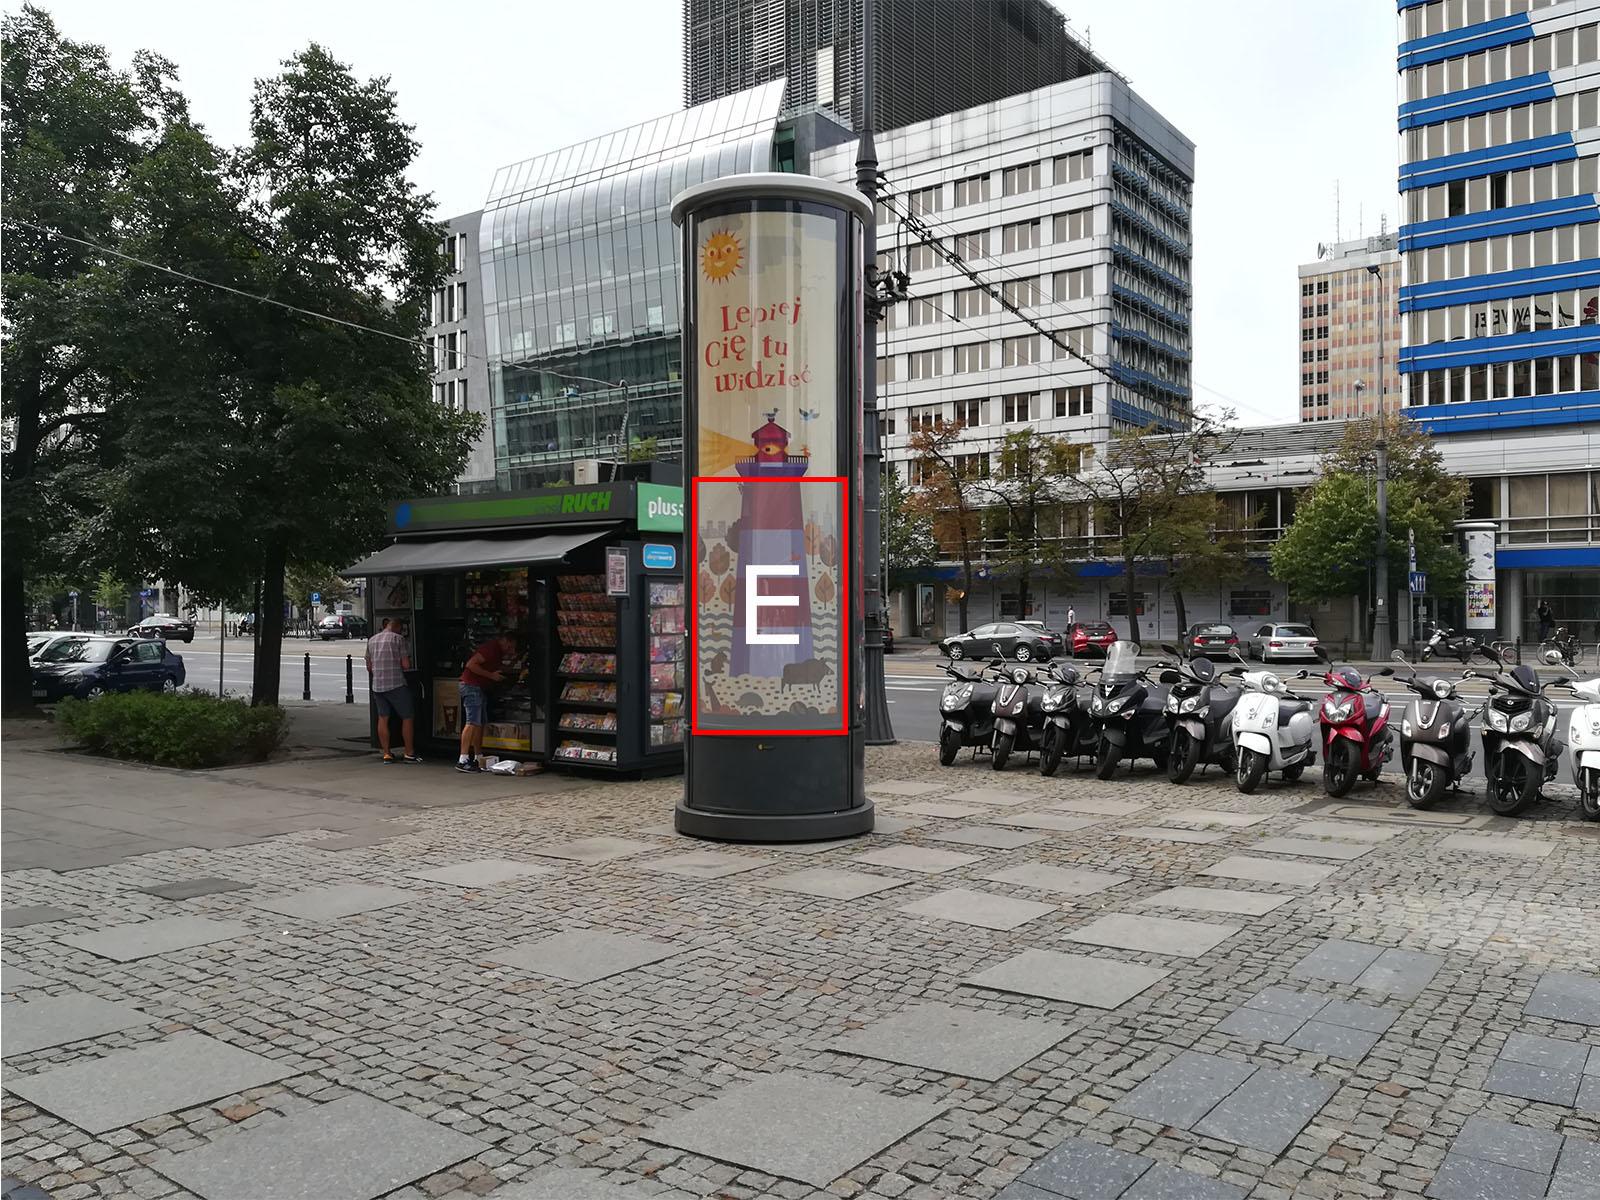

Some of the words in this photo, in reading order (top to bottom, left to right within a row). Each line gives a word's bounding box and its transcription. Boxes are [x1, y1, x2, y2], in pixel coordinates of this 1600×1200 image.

[720, 296, 801, 332] Lepiej
[705, 335, 746, 367] Cię
[761, 335, 788, 359] tu
[714, 361, 812, 393] widzieć
[561, 490, 613, 513] RUCH
